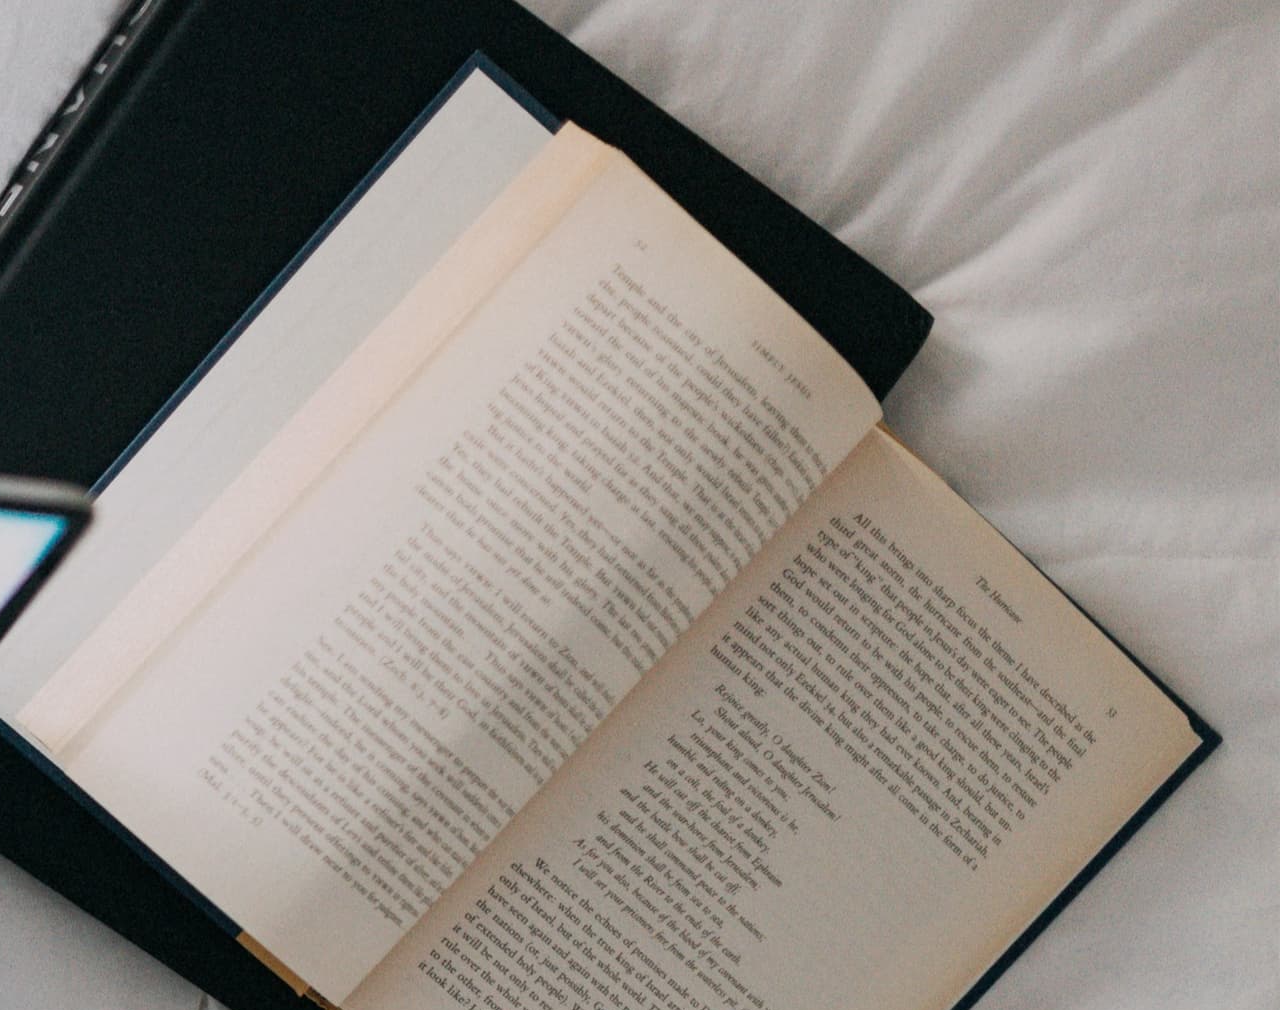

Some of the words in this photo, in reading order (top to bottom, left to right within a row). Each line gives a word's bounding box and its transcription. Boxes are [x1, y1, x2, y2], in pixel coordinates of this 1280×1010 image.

[852, 513, 872, 529] All
[869, 527, 887, 545] this
[887, 541, 915, 570] brings
[914, 568, 933, 587] into
[931, 585, 956, 609] sharp
[955, 605, 978, 629] focus
[977, 626, 992, 643] the
[991, 640, 1015, 666] theme
[1020, 667, 1040, 690] have
[1039, 687, 1077, 724] described
[1082, 729, 1096, 744] the
[771, 734, 783, 745] O
